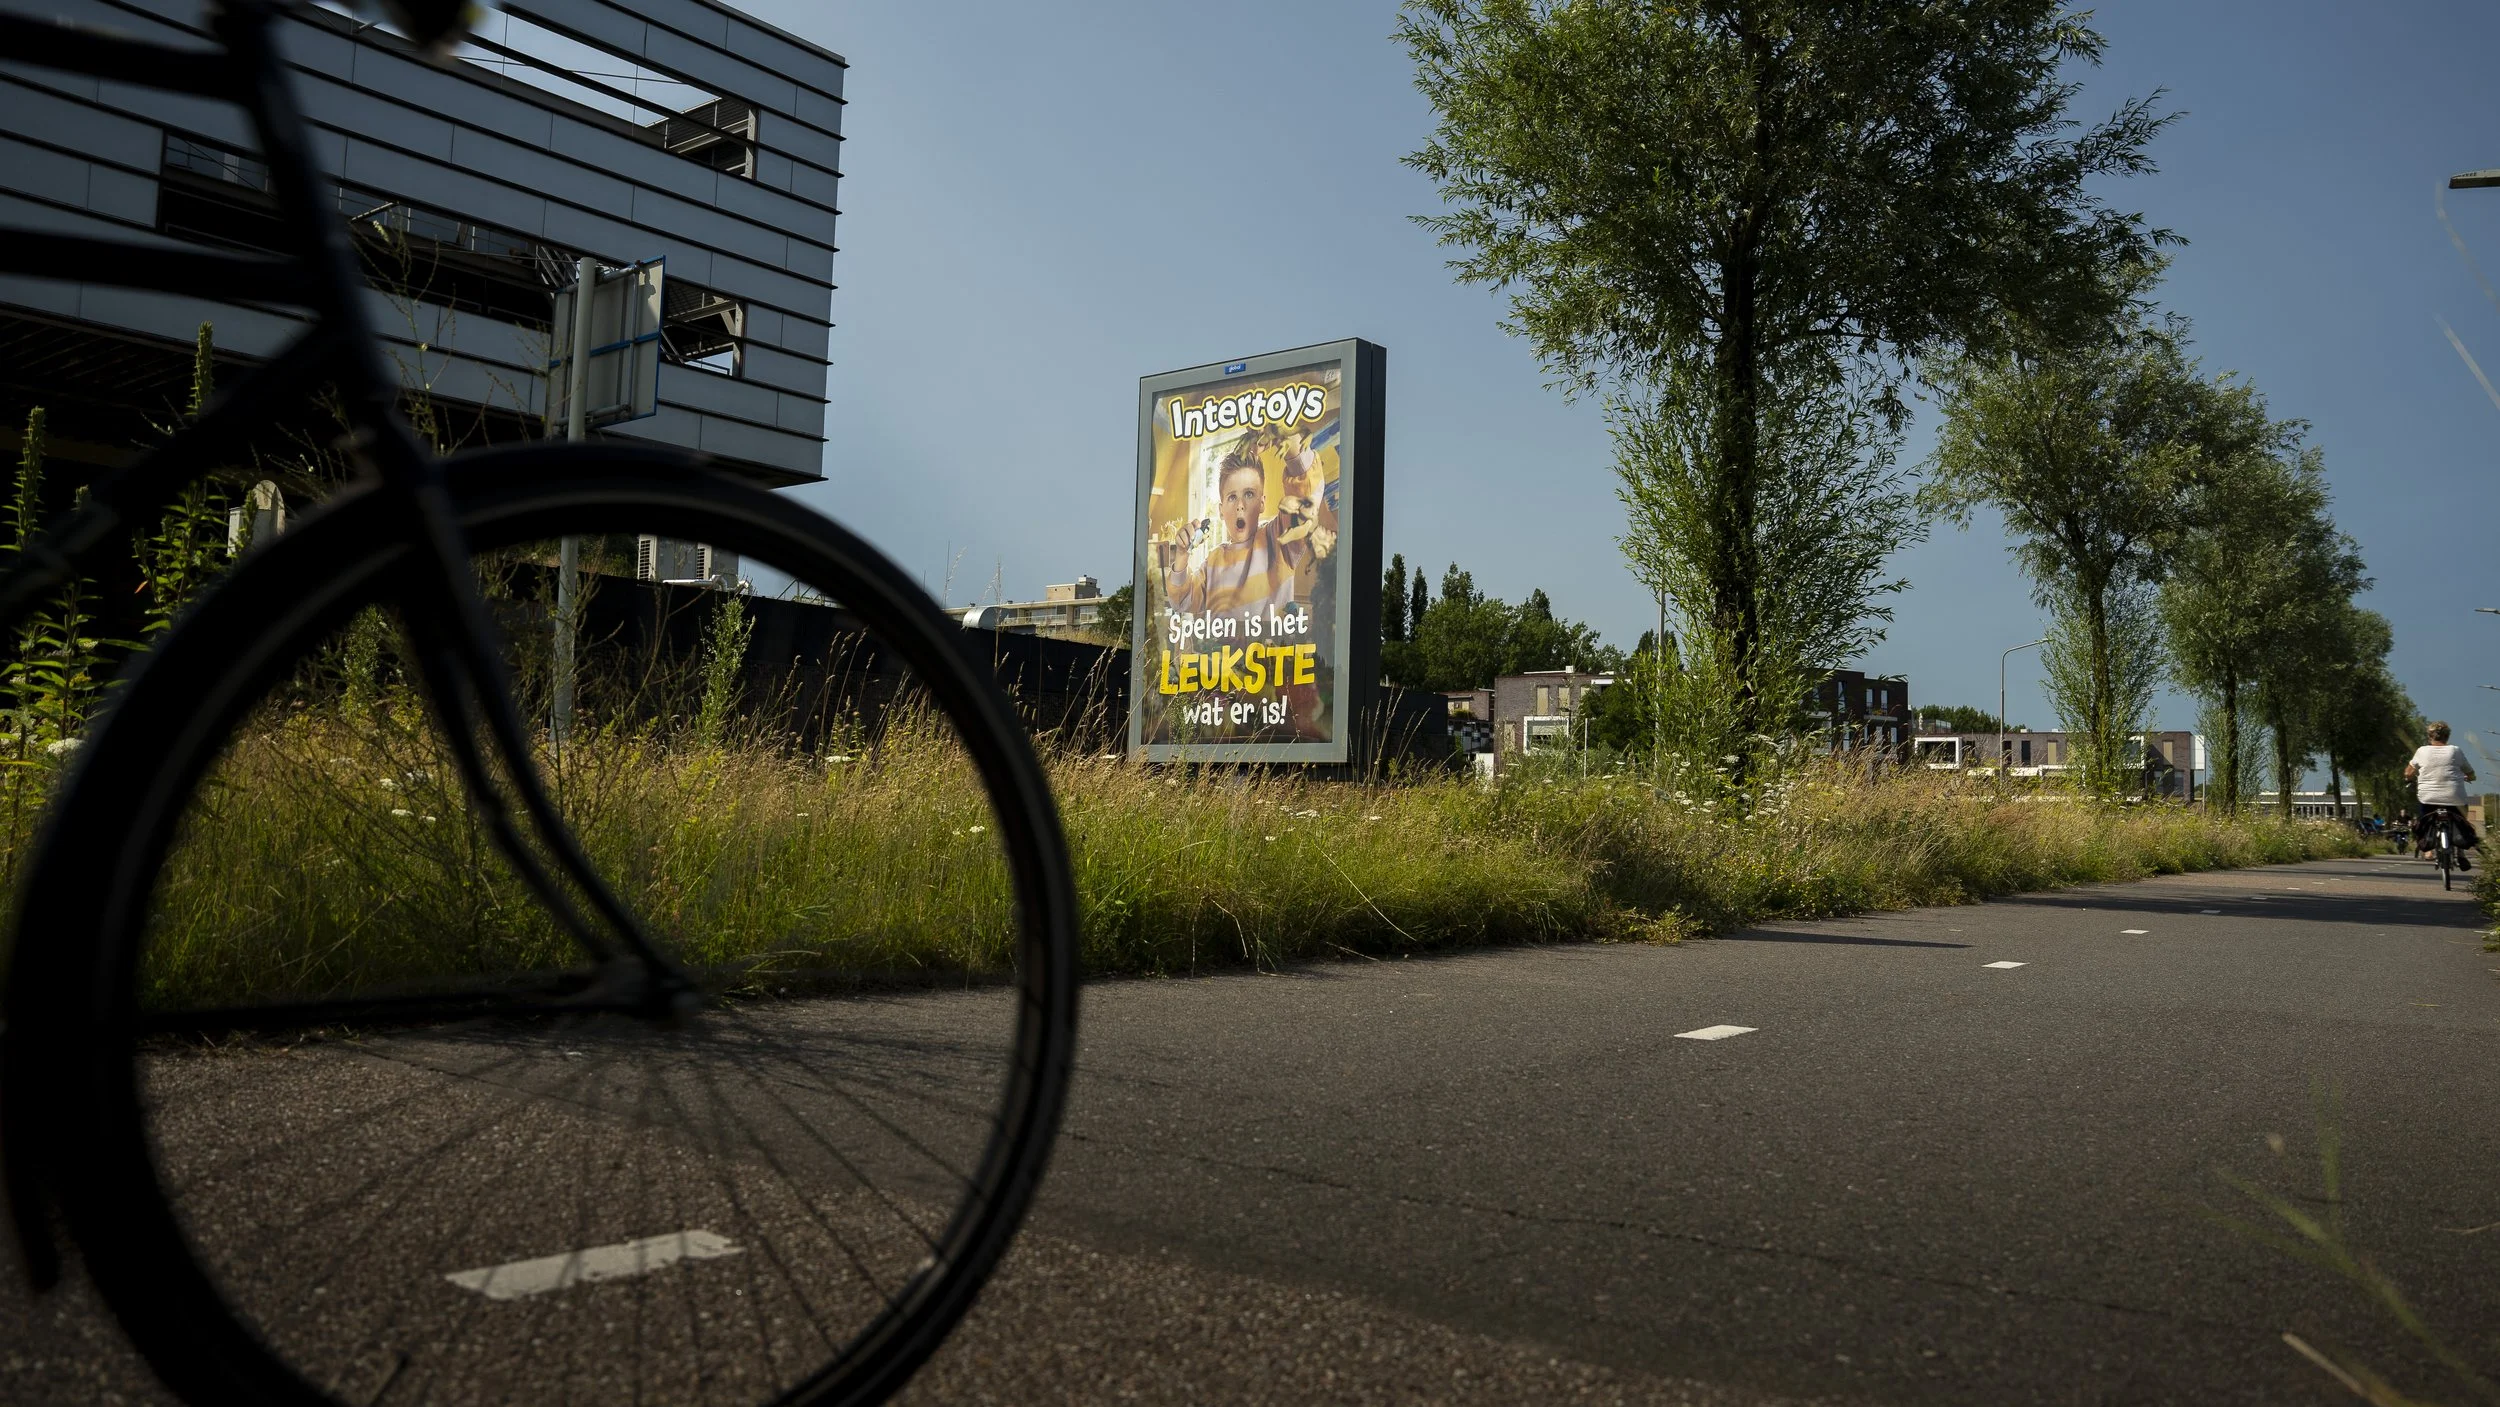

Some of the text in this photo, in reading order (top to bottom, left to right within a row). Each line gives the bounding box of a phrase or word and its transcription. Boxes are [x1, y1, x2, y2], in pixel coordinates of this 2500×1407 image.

[1170, 384, 1326, 439] Intertoys
[1168, 604, 1309, 650] Spelen is het
[1159, 642, 1316, 695] LEUKSTE
[1182, 695, 1288, 726] wat er is!
